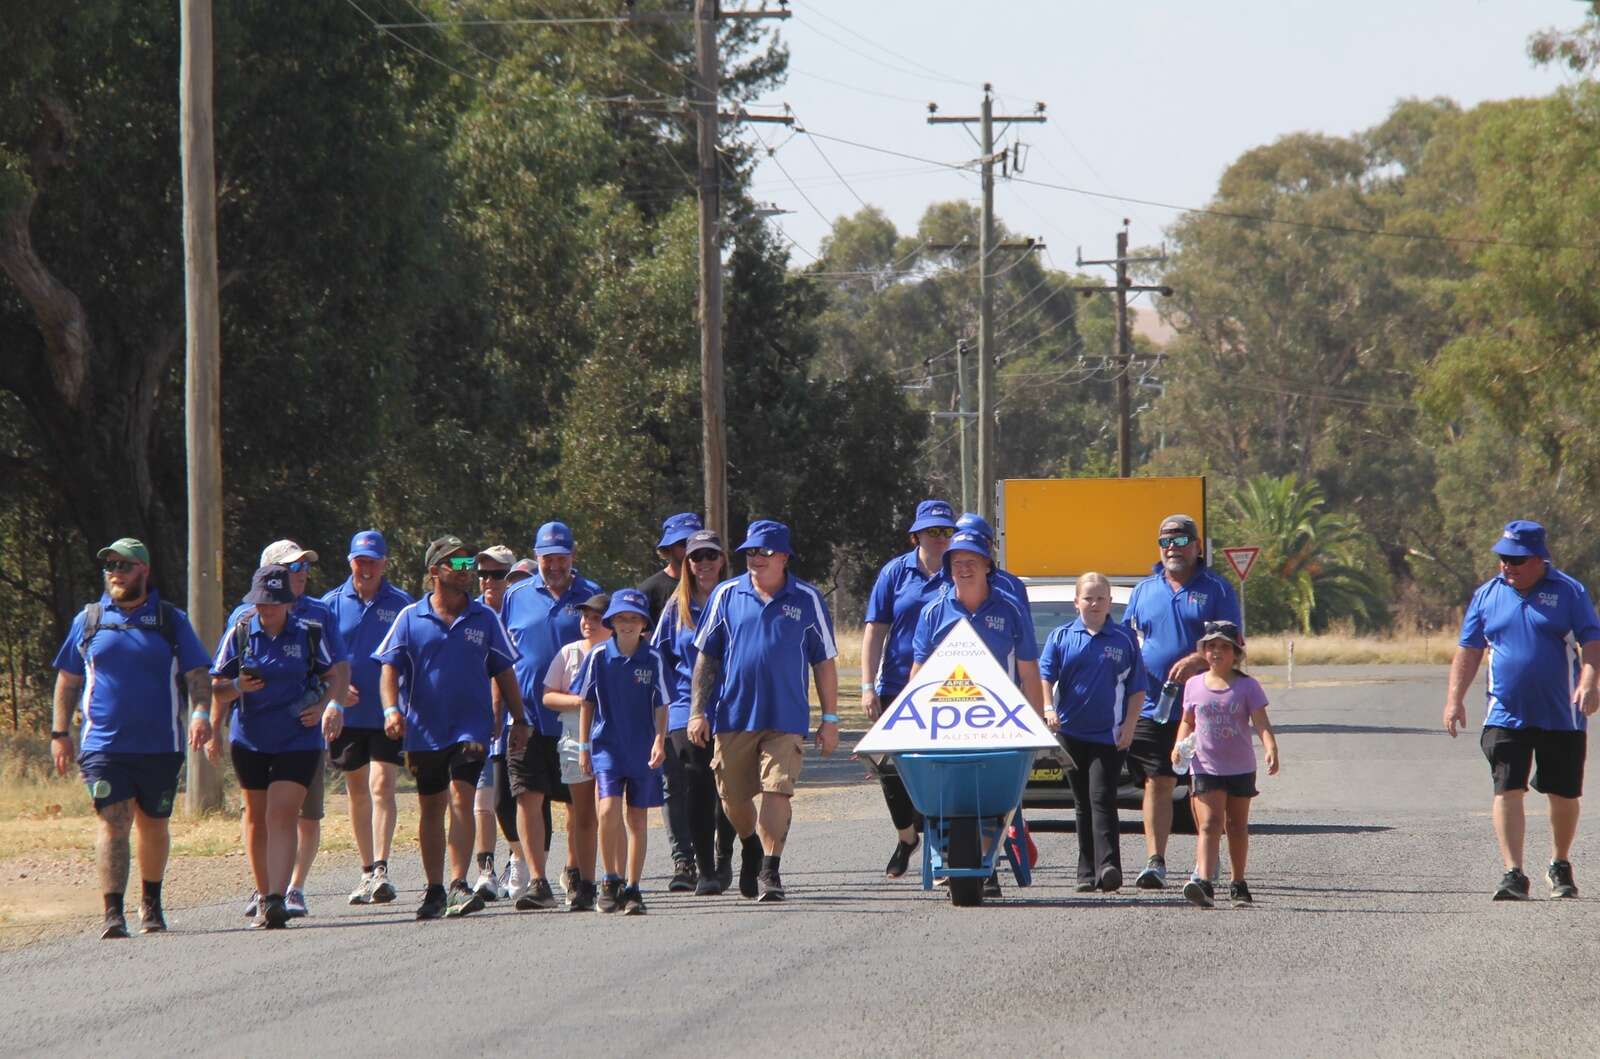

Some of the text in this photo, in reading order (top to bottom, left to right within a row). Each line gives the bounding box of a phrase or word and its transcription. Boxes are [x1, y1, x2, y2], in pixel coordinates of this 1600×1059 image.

[1539, 592, 1558, 600] CLUB
[1541, 600, 1557, 608] PUB
[783, 604, 801, 614] CLUB
[786, 611, 801, 620] PUB
[985, 616, 1005, 624] CLUB
[988, 622, 1004, 632] PUB
[464, 628, 484, 637] CLUB
[467, 635, 482, 645] PUB
[1105, 646, 1123, 655] CLUB
[1107, 652, 1121, 661] PUB
[882, 688, 1035, 740] Apex
[942, 732, 1023, 740] AUSTRALIA
